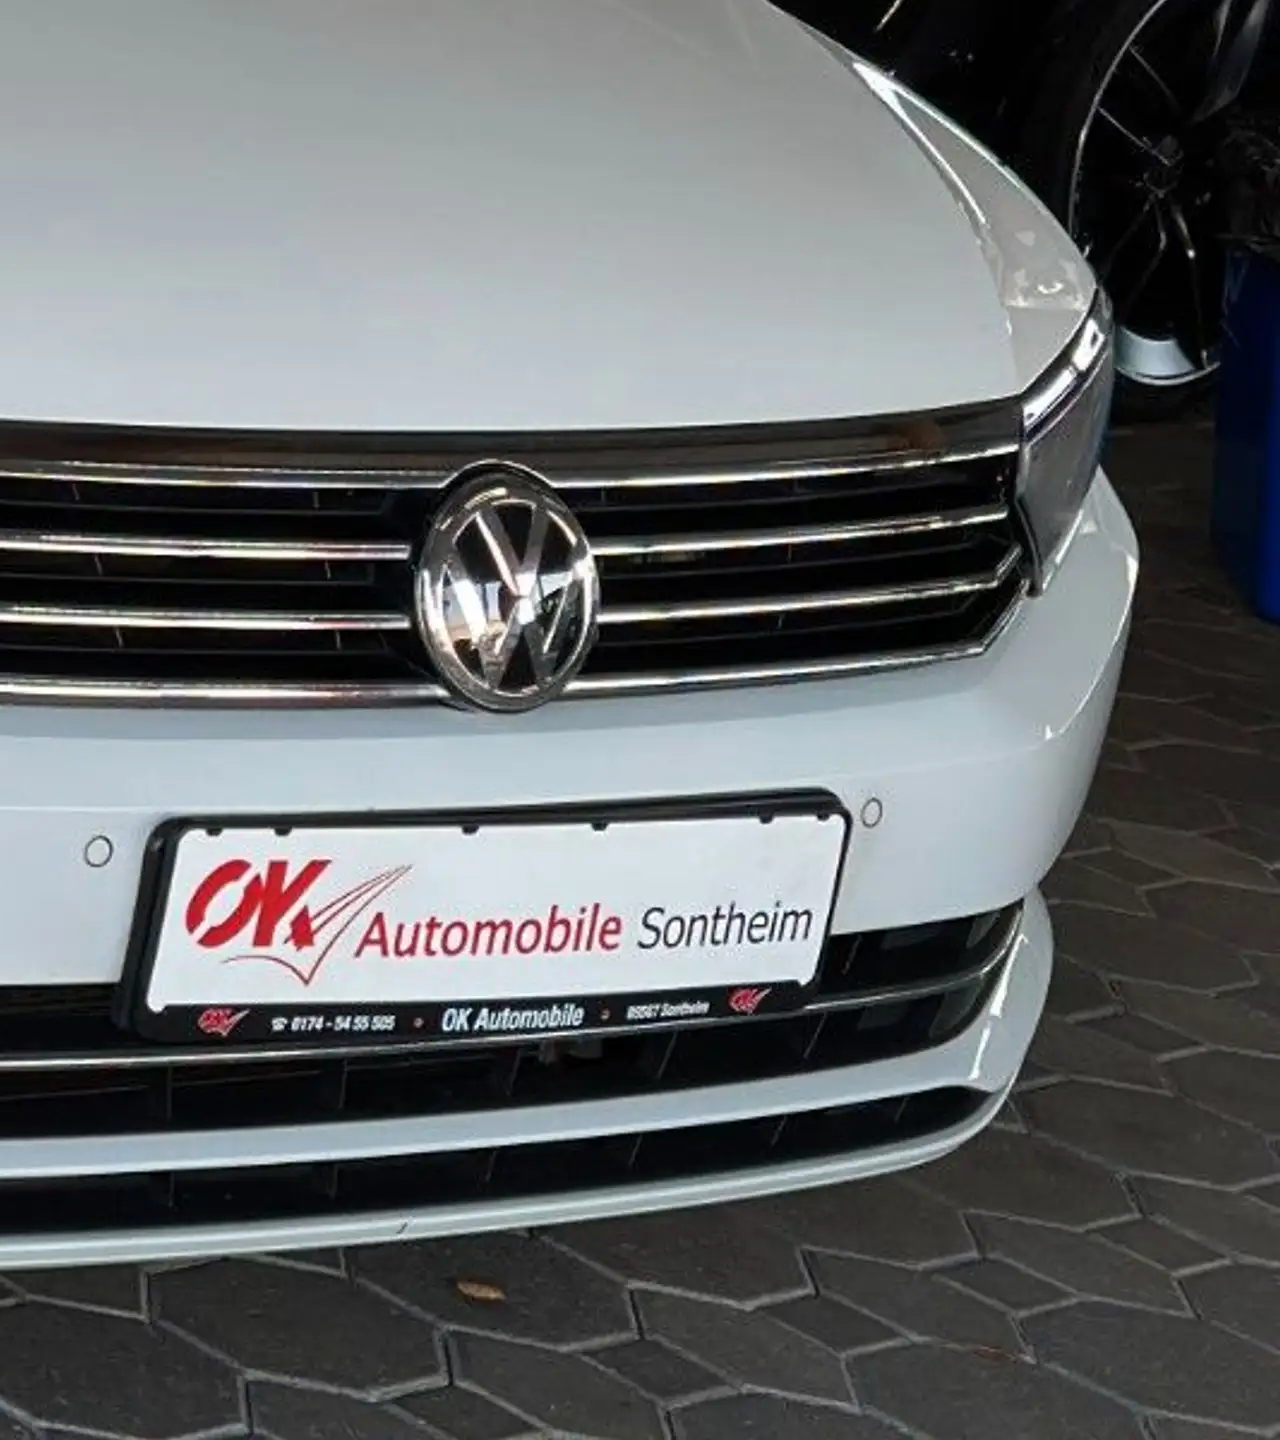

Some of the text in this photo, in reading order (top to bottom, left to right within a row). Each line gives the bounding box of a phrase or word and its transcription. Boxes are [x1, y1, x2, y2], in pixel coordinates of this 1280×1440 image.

[184, 858, 814, 959] OK Automobile Sontheim
[290, 1014, 325, 1032] 0174
[441, 1007, 471, 1033] OK
[474, 1002, 585, 1032] Automobile
